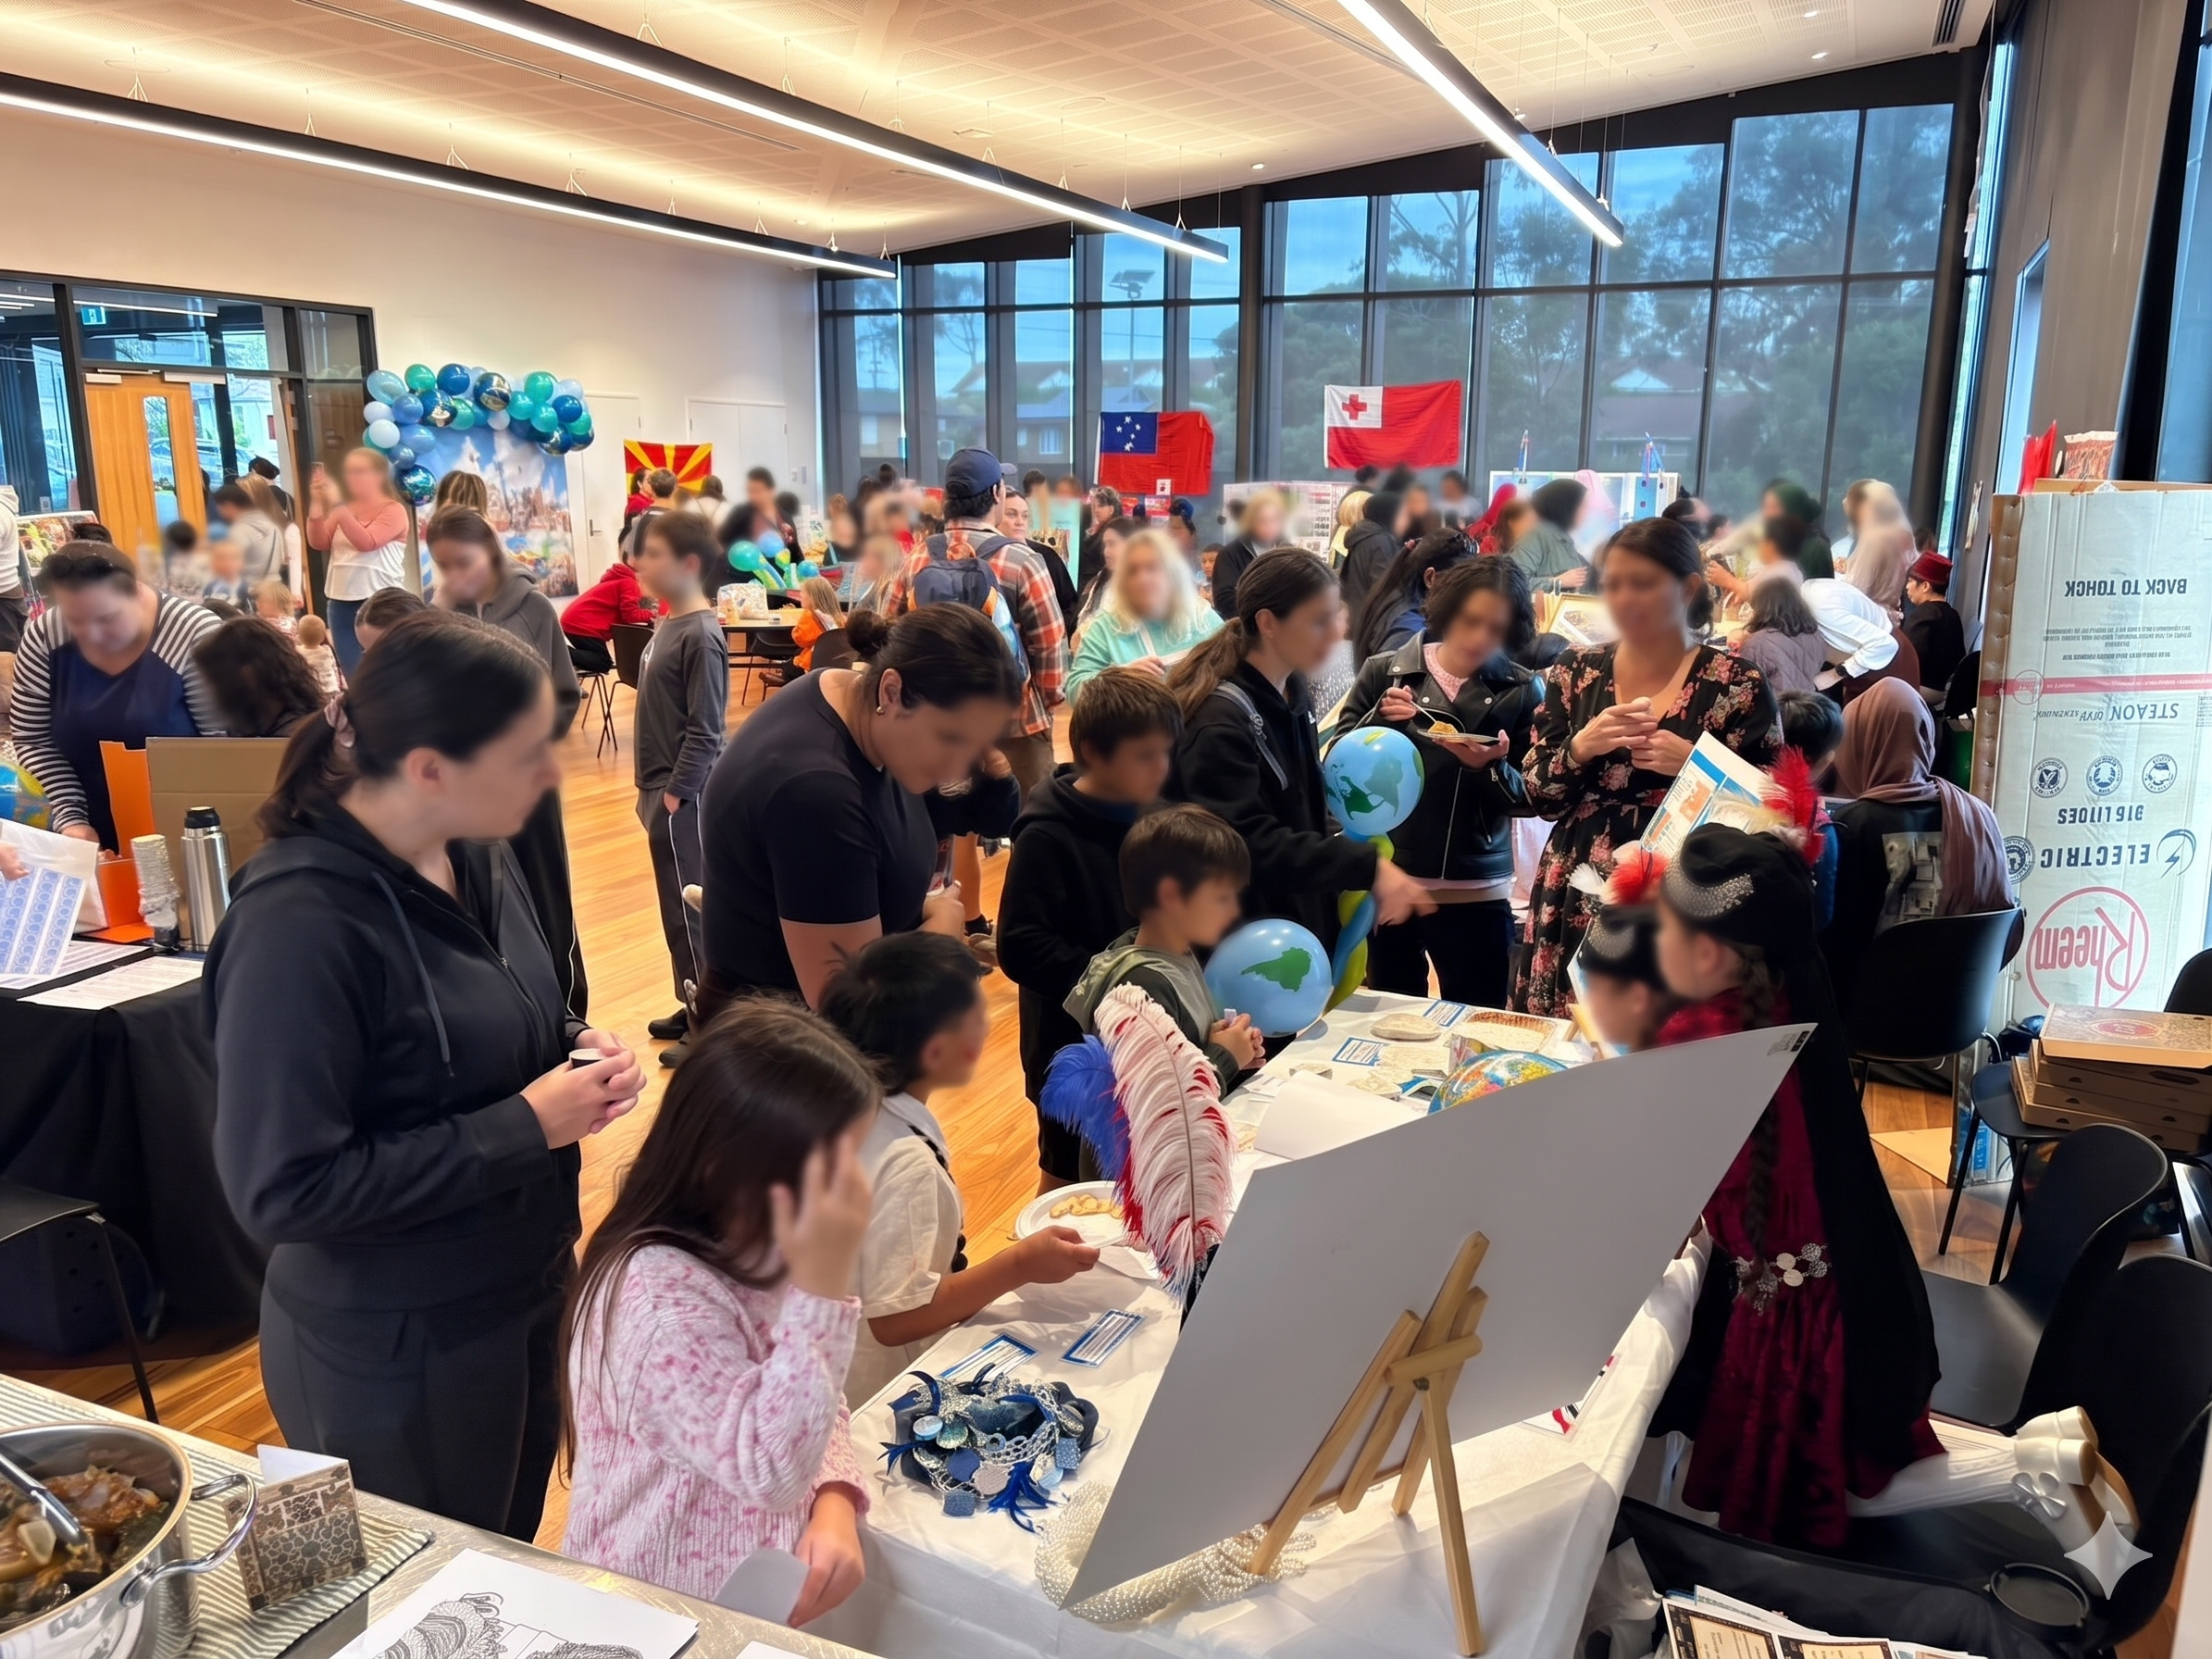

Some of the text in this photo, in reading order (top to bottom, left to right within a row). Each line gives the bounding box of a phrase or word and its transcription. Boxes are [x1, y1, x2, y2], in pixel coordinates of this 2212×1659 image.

[2121, 580, 2141, 595] TO
[2145, 579, 2187, 595] BACK
[2040, 843, 2151, 868] ELECTRIC
[2034, 907, 2135, 1008] Rheem
